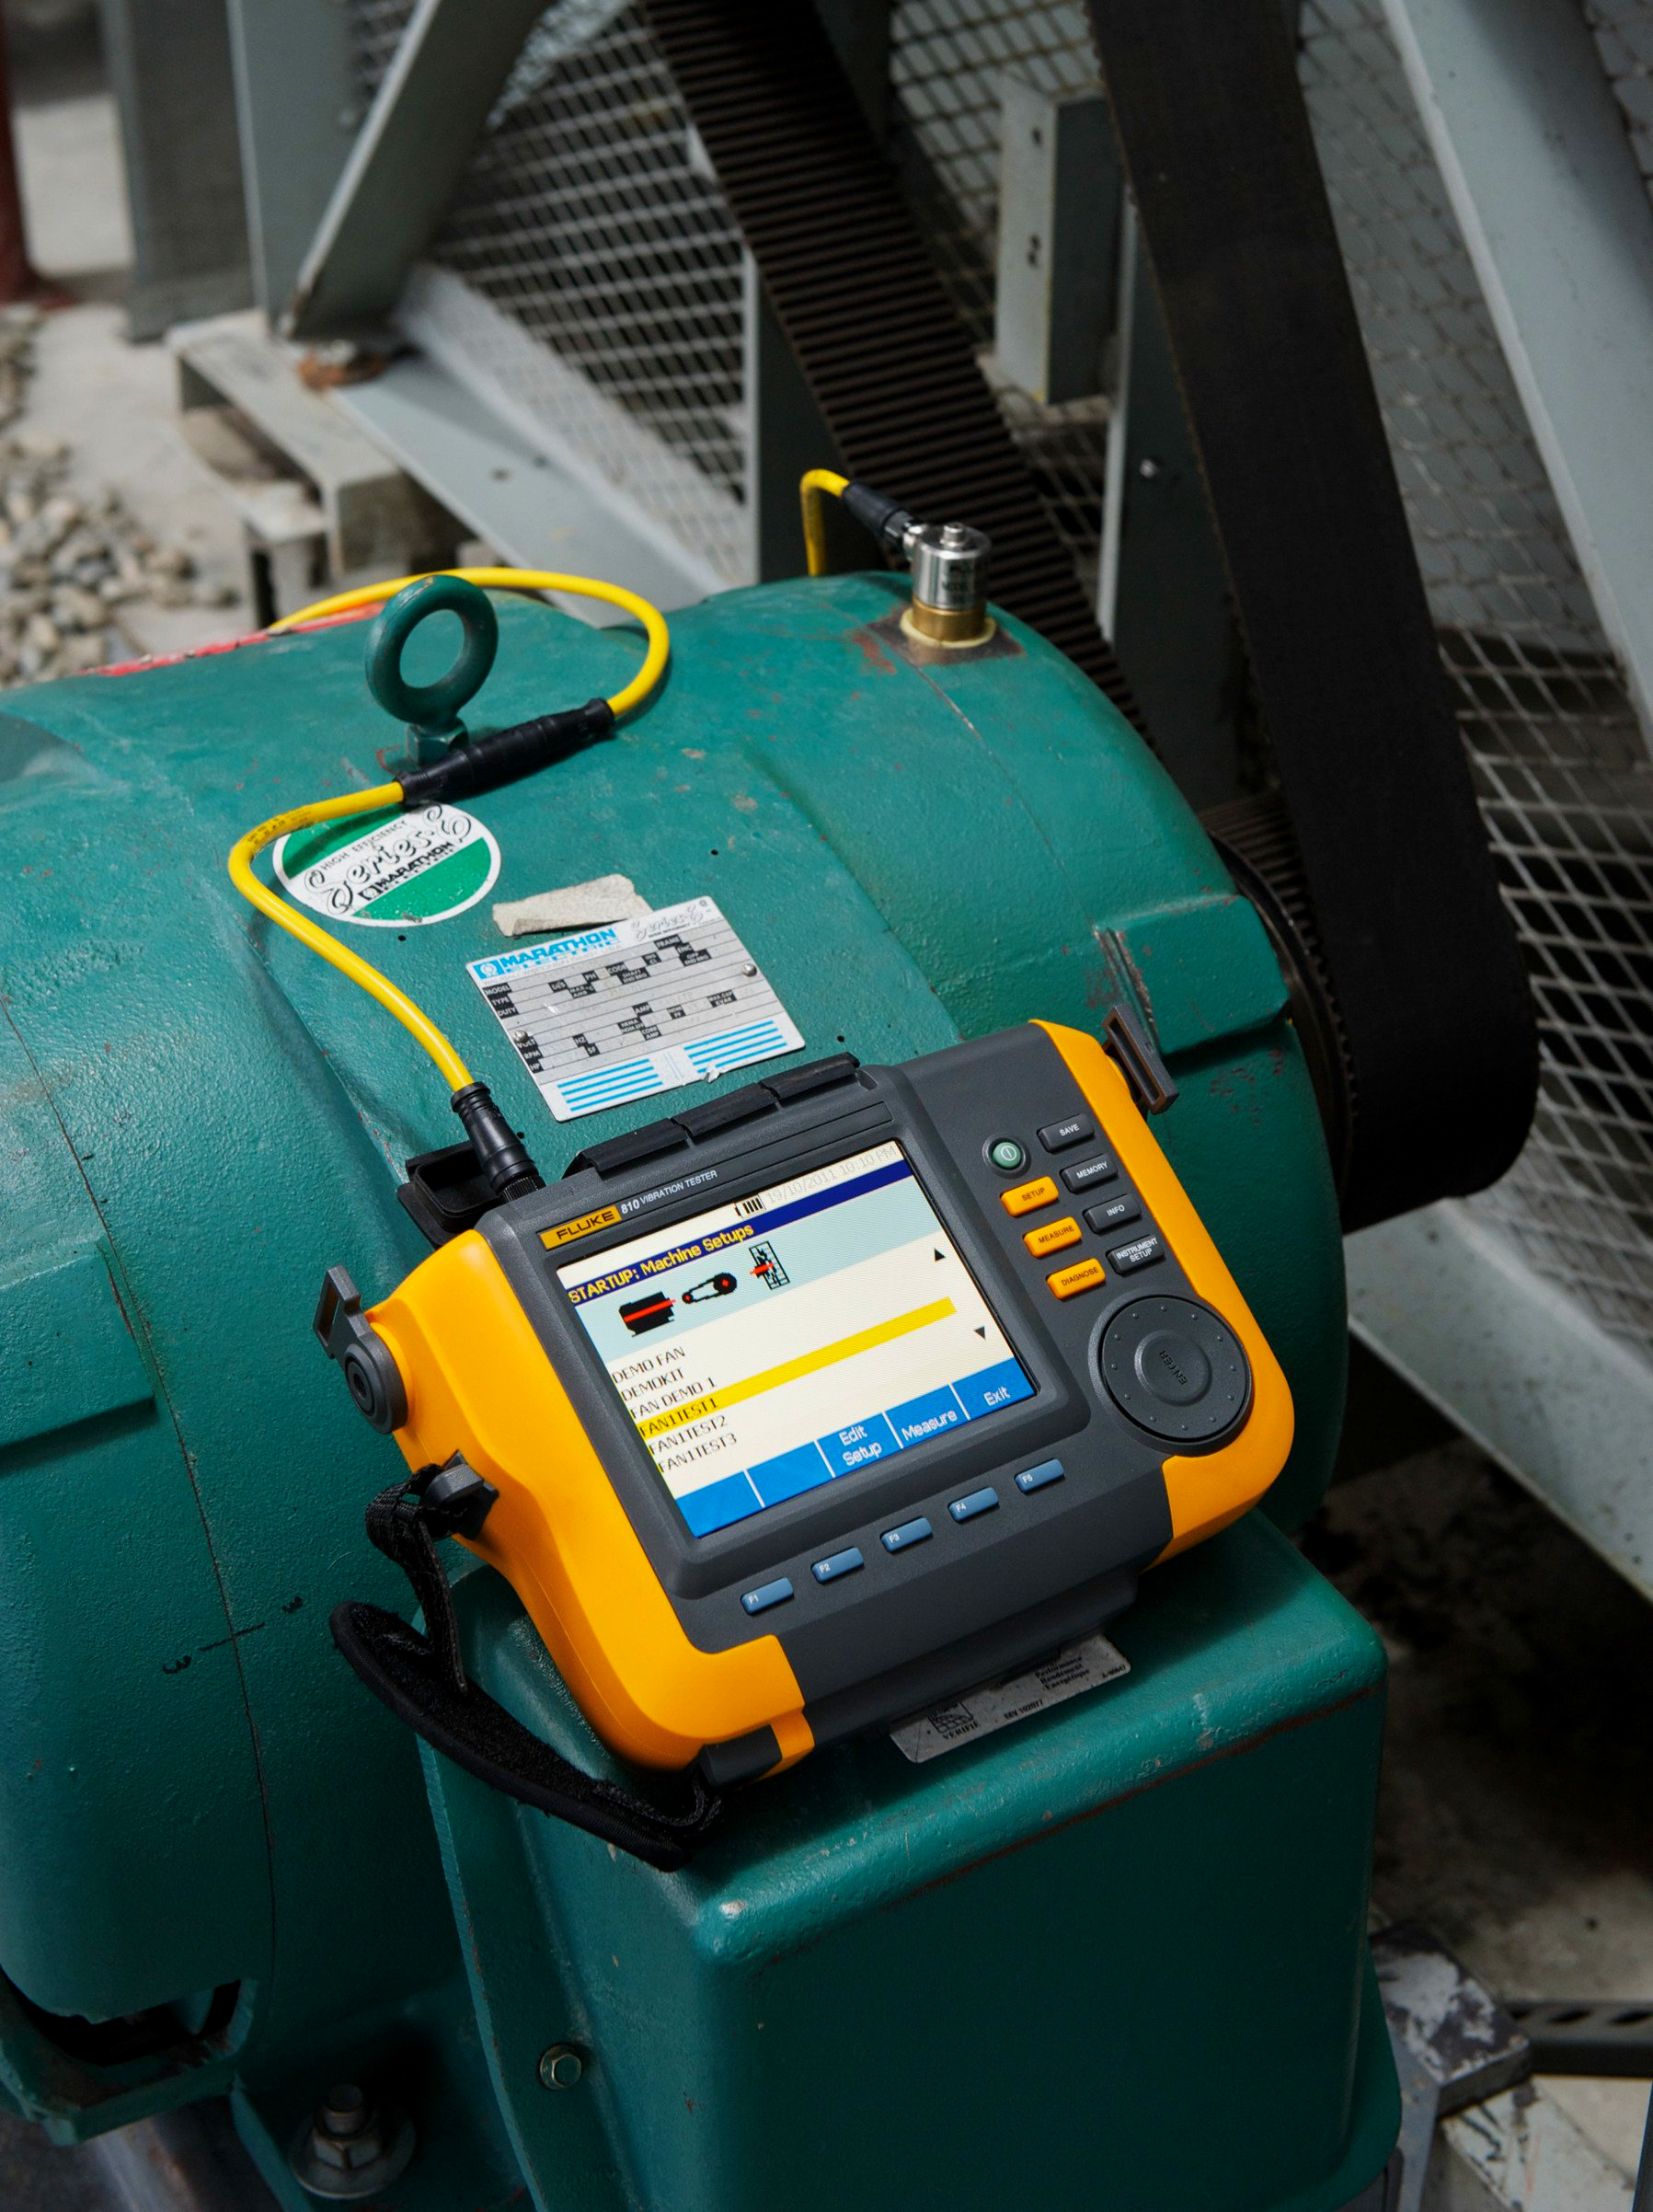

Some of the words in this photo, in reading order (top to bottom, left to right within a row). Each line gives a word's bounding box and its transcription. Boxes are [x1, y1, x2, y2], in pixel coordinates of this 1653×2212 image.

[320, 851, 350, 871] HIGH
[351, 820, 408, 853] EFFICIENCY
[374, 841, 454, 889] MARATHON
[499, 927, 617, 967] MARATHON
[484, 985, 511, 997] MODEL
[656, 935, 681, 949] FRAME
[491, 997, 511, 1006] TYPE
[586, 972, 597, 981] PH
[497, 1007, 518, 1017] DUTY
[635, 1004, 652, 1013] AMP
[523, 1051, 541, 1059] RPM
[530, 1063, 541, 1071] HP
[1059, 1123, 1080, 1137] SAVE
[875, 1145, 898, 1162] PM
[1075, 1161, 1108, 1180] MEMORY
[621, 1200, 640, 1215] 810
[640, 1182, 684, 1204] VIBRATION
[684, 1169, 718, 1188] TESTER
[1021, 1187, 1046, 1202] SETUP
[1107, 1204, 1125, 1217] INFO
[557, 1210, 615, 1240] FLUKE
[1039, 1225, 1074, 1244] MEASURE
[1116, 1237, 1158, 1261] INSTRUMENT
[1130, 1247, 1153, 1263] SETUP
[568, 1269, 639, 1305] STARTUP:
[640, 1242, 702, 1276] Machine
[702, 1224, 754, 1252] Setups
[1061, 1266, 1100, 1286] DIAGNOSE
[612, 1359, 654, 1384] DEMO
[656, 1346, 685, 1366] FAN
[1159, 1349, 1188, 1386] ENTER
[621, 1368, 684, 1401] DEMOKIT
[630, 1399, 660, 1420] FAN
[660, 1381, 704, 1407] DEMO
[707, 1377, 717, 1388] 1
[983, 1386, 1011, 1406] Exit
[839, 1424, 867, 1446] Edit
[901, 1410, 959, 1442] Measure
[843, 1442, 882, 1467] Setup
[1022, 1473, 1034, 1484] F5
[956, 1502, 968, 1514] F4
[889, 1533, 901, 1544] F3
[820, 1562, 831, 1574] F2
[748, 1595, 759, 1605] F1
